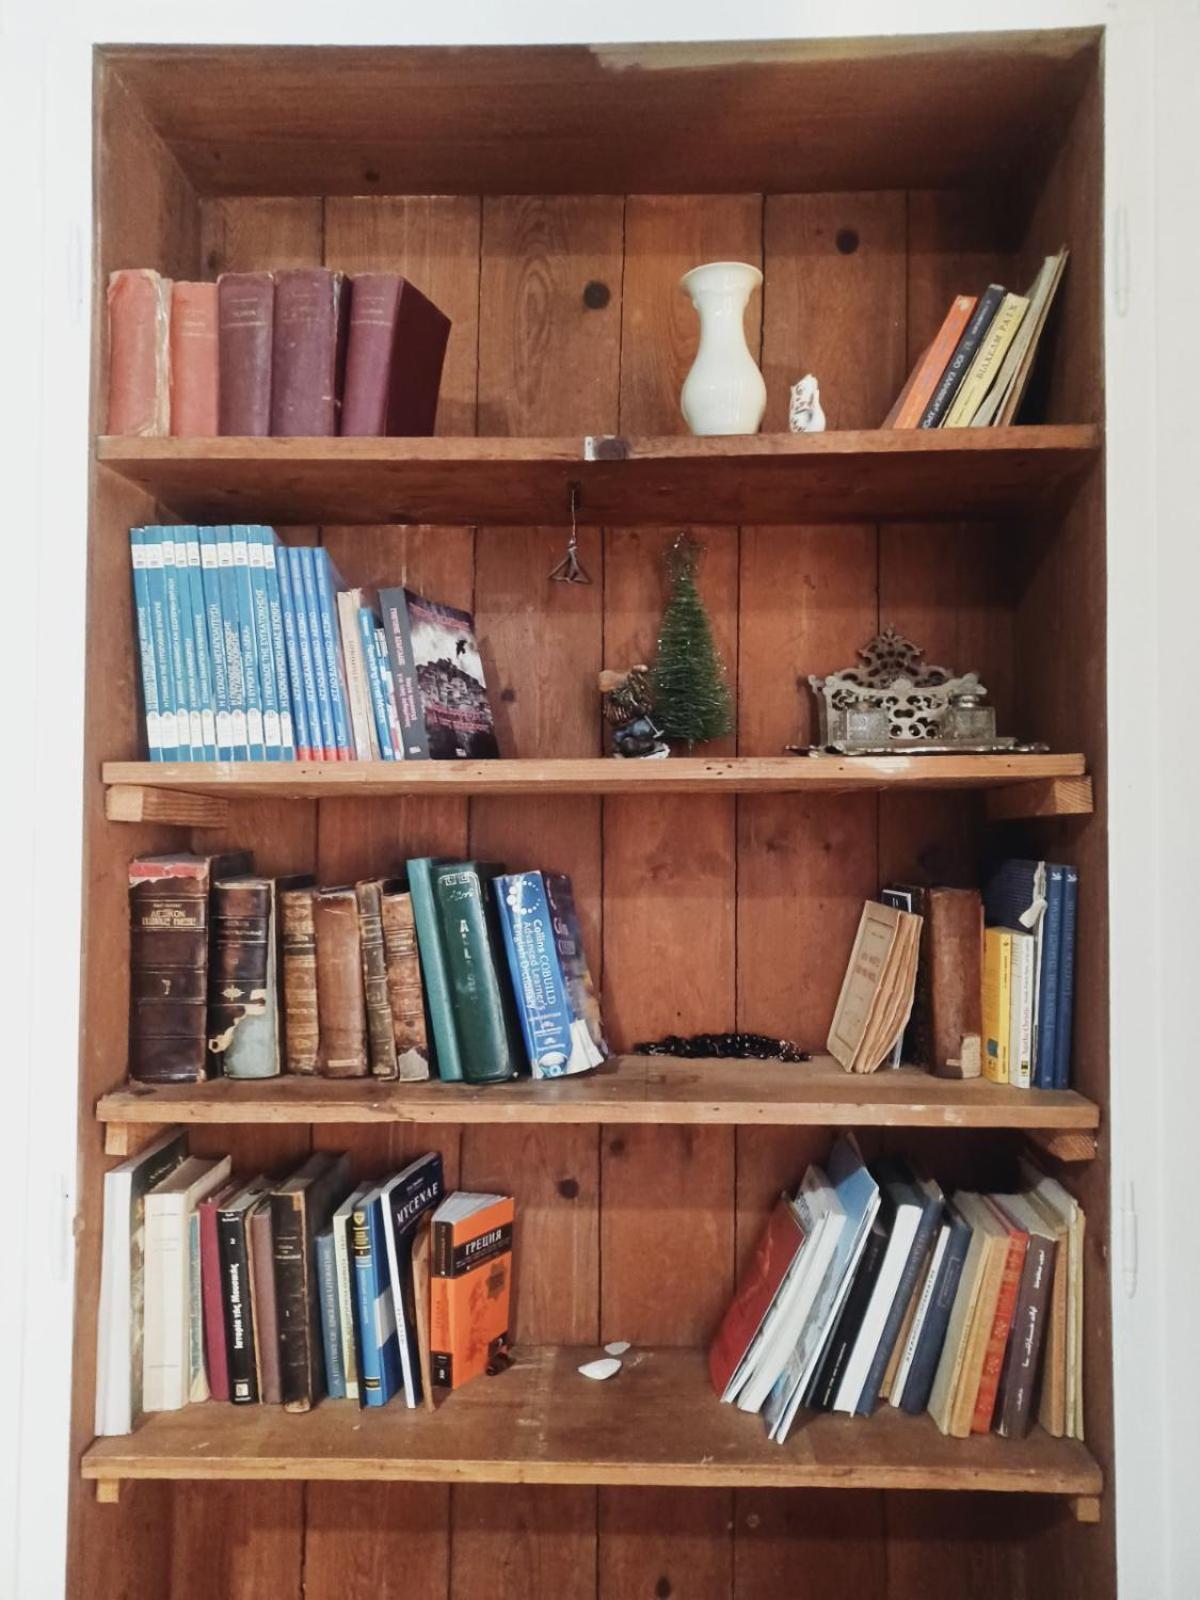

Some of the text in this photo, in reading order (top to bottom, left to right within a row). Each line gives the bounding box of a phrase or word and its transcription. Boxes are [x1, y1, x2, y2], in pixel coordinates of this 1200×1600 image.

[522, 920, 538, 965] Advanced
[532, 918, 557, 1004] Collins COBUILD
[396, 1182, 439, 1226] MYCENAE
[465, 1228, 502, 1256] ГРЕЦИЯ
[322, 1248, 334, 1291] LITERATURE
